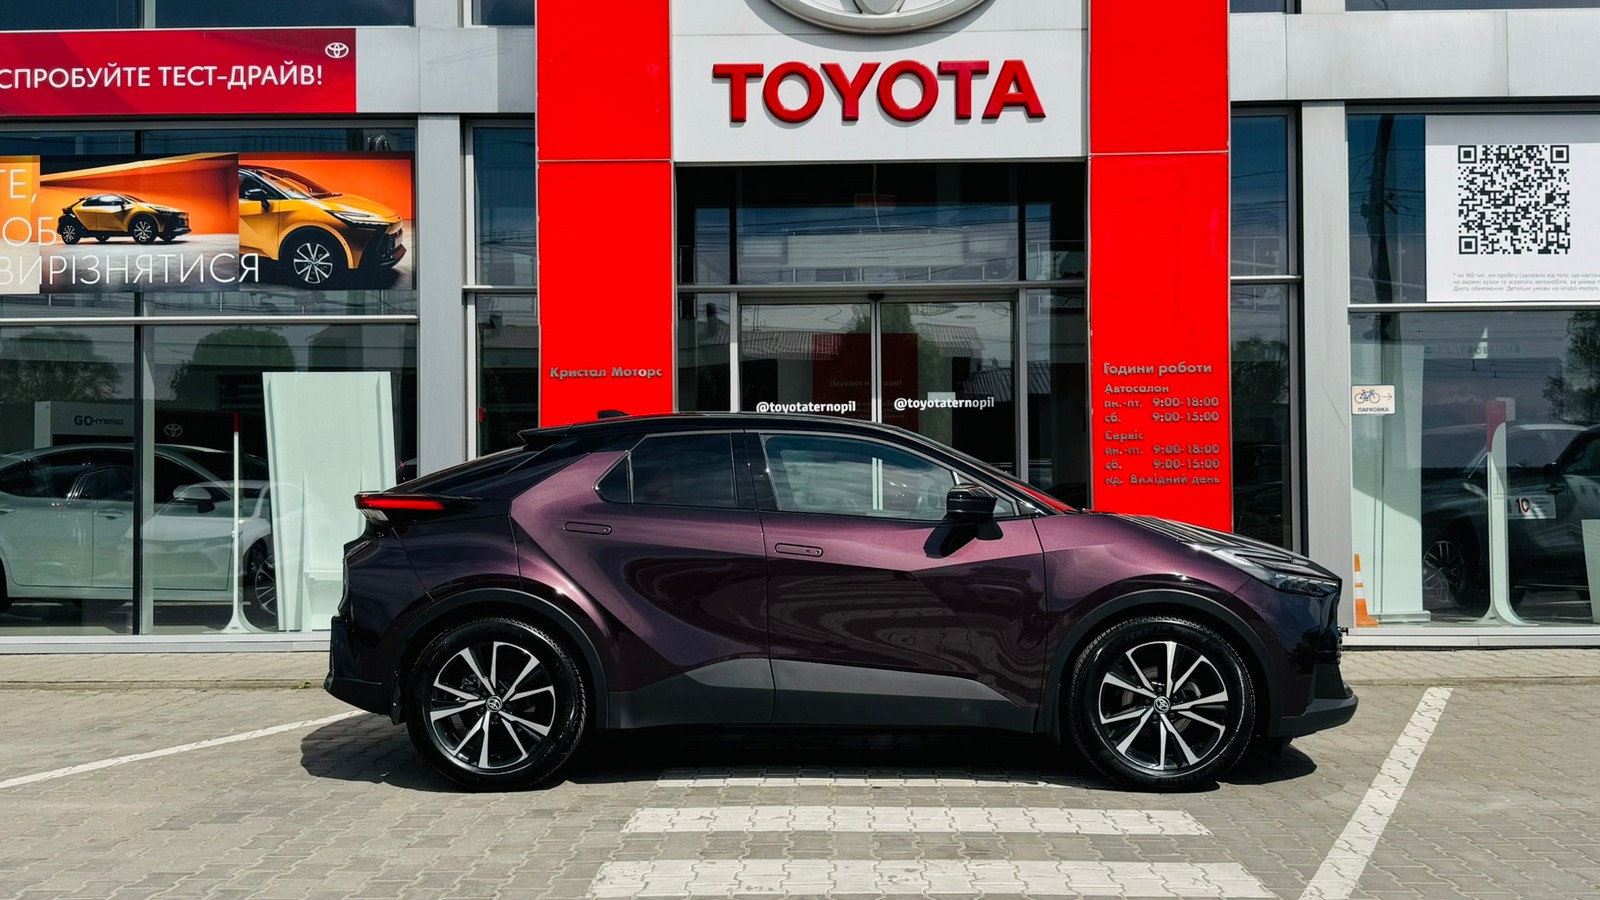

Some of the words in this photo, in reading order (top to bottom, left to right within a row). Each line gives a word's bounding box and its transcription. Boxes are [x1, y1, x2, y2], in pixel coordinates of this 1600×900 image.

[0, 62, 150, 89] СПРОБУЙТЕ
[158, 60, 323, 90] ТЕСТ-ДРАЙВ!
[712, 59, 1046, 123] TOYOTA
[0, 169, 37, 204] Е,
[0, 253, 259, 286] ВИРІЗНЯТИСЯ
[550, 367, 607, 380] Кристал
[611, 367, 662, 379] Моторс
[1103, 363, 1154, 375] Години
[1158, 361, 1212, 376] роботи
[1104, 384, 1169, 394] Автосалон
[756, 400, 856, 414] @toyotaternopil
[894, 397, 995, 412] @toyotaternopil
[1104, 412, 1121, 422] сб.
[1105, 430, 1143, 442] Сервіс
[1105, 459, 1122, 469] сб.
[1130, 473, 1187, 485] Вихідний
[1191, 476, 1220, 485] день
